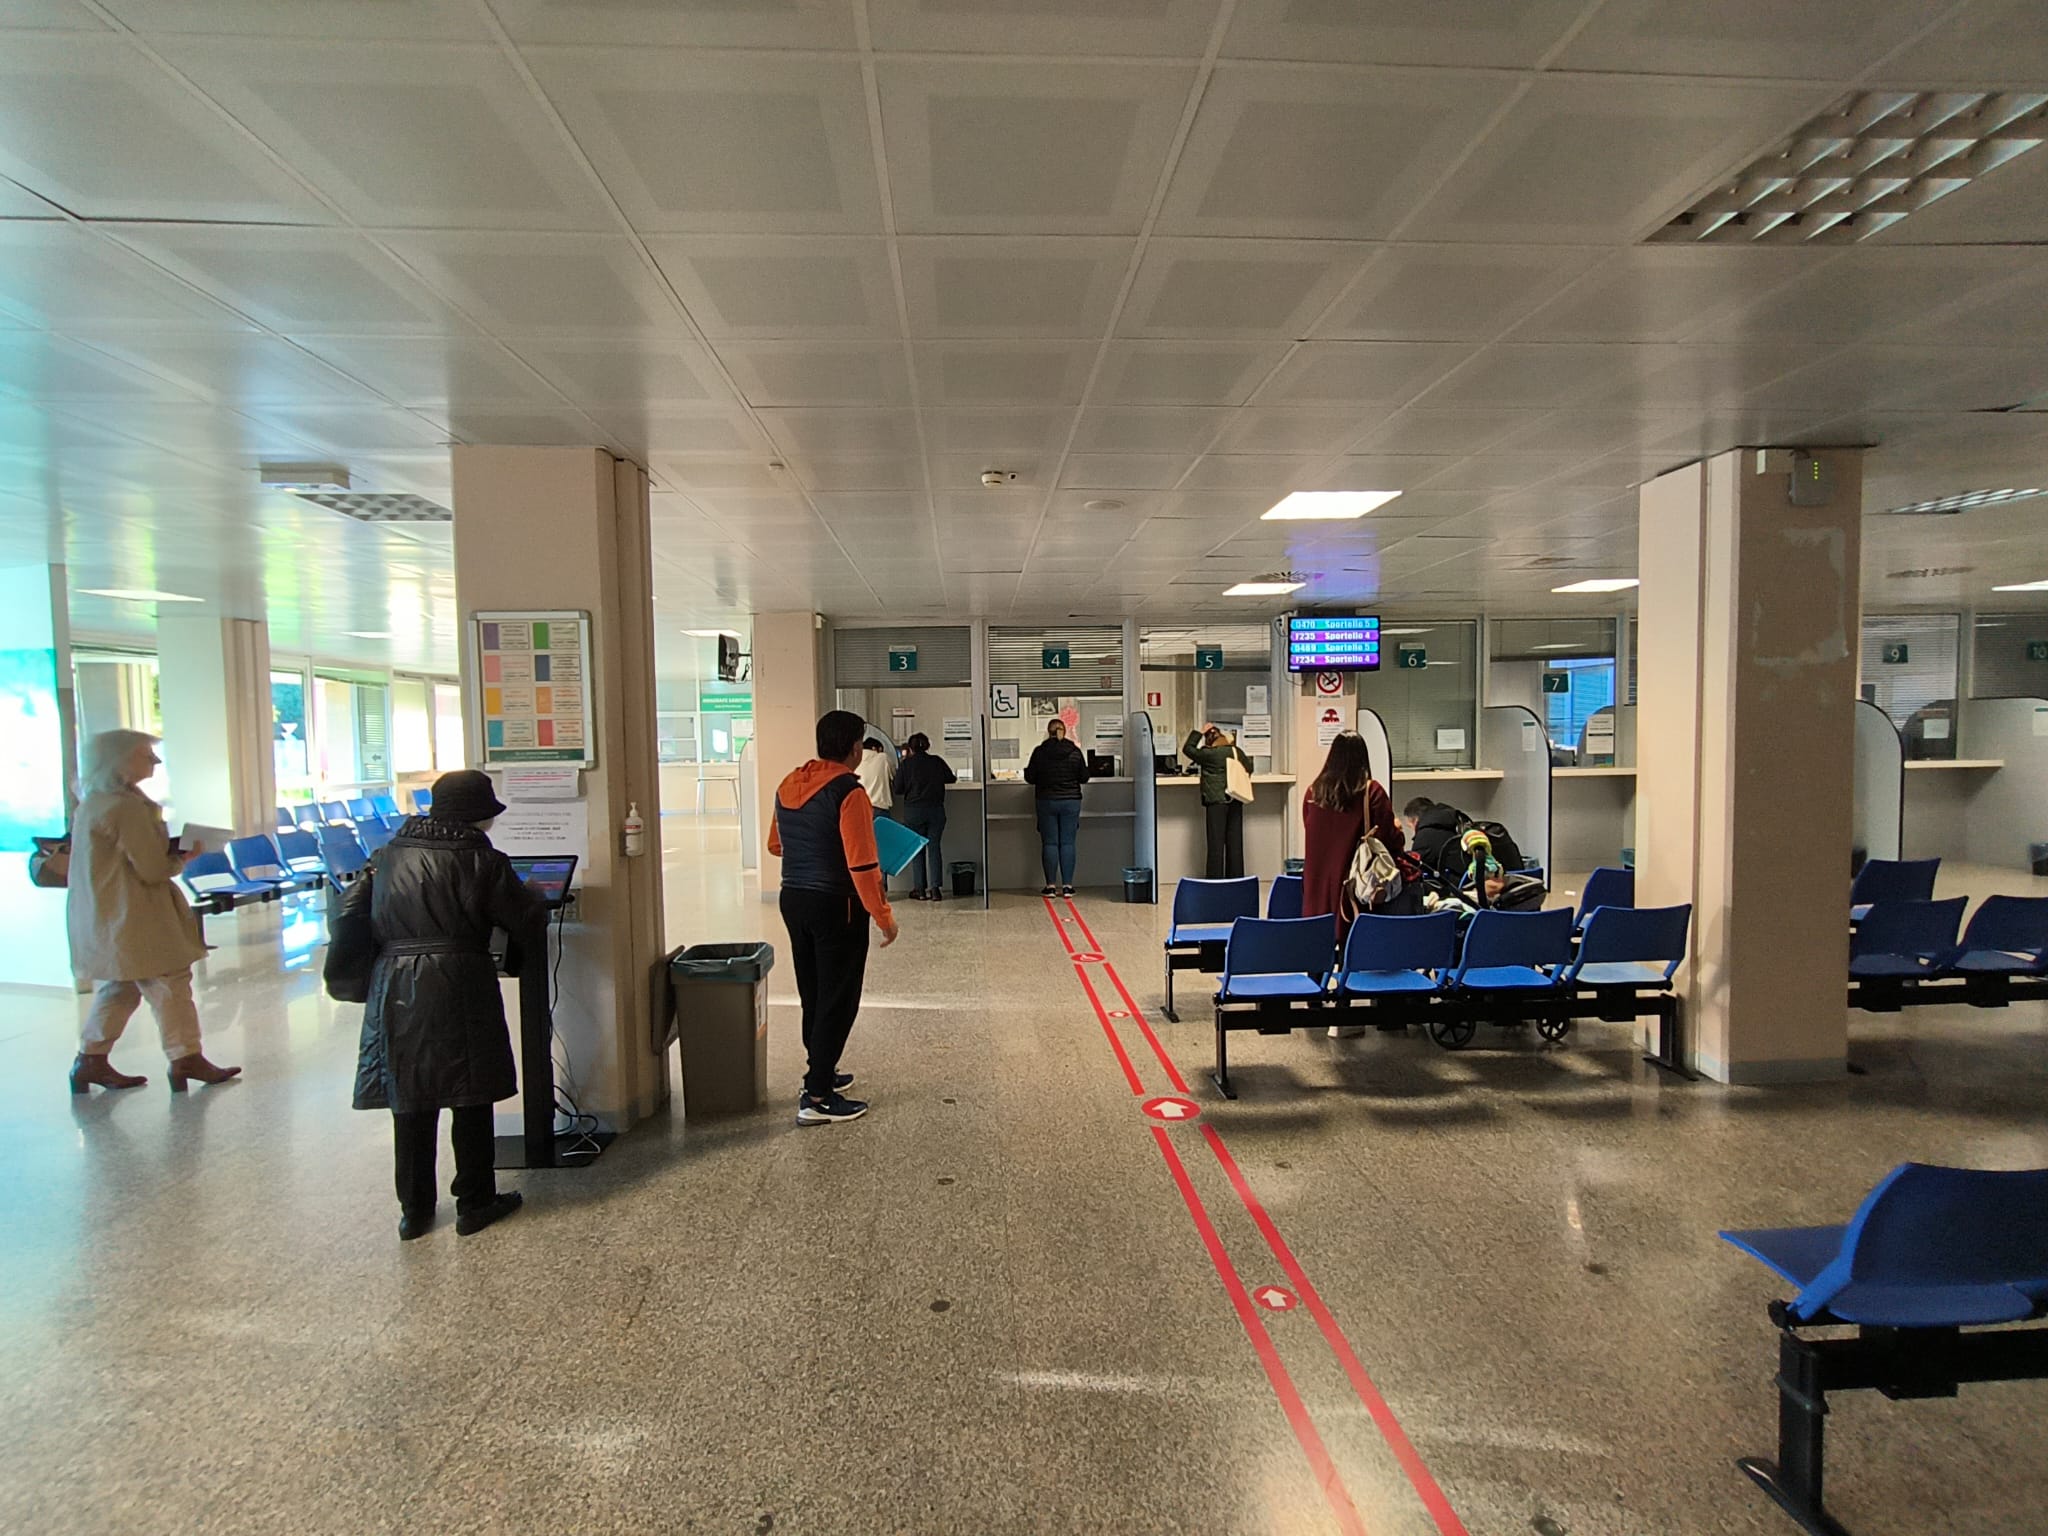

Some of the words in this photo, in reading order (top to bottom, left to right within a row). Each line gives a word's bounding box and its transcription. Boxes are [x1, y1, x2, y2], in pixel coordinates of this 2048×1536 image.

[1325, 620, 1363, 629] Sportello
[1364, 620, 1370, 628] 5
[1325, 632, 1363, 641] Sportello
[1364, 632, 1370, 640] 4
[1325, 644, 1363, 653] Sportello
[1364, 644, 1370, 652] 5
[2033, 646, 2047, 659] 10
[1051, 654, 1061, 667] 4
[1205, 655, 1214, 669] 5
[1325, 655, 1363, 664] Sportello
[1364, 655, 1370, 663] 4
[1408, 653, 1417, 667] 6
[1890, 649, 1899, 662] 9
[899, 656, 908, 670] 3
[1551, 678, 1559, 691] 7
